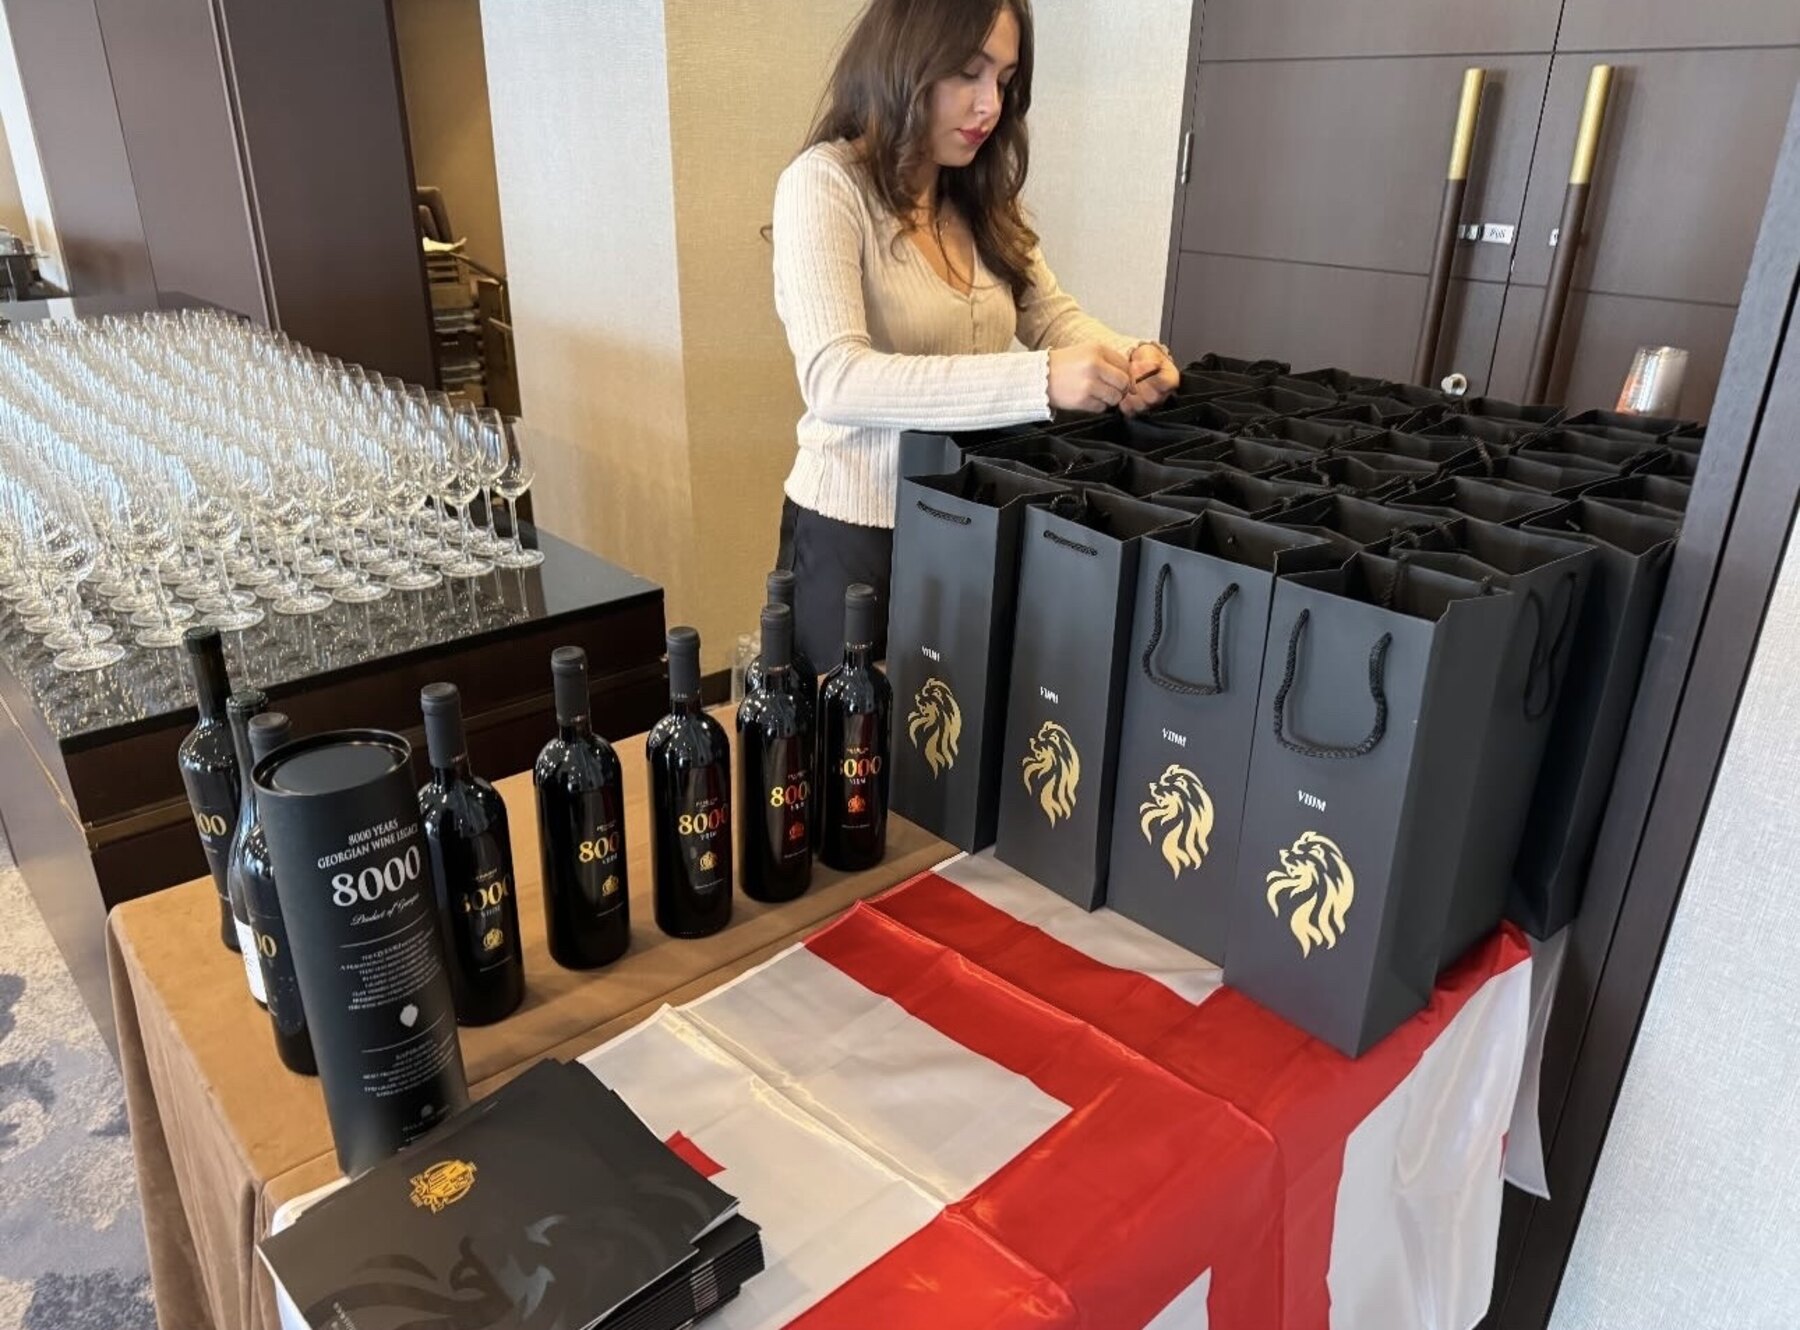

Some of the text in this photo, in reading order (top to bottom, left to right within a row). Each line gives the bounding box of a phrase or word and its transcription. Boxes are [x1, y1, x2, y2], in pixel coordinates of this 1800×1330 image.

[348, 819, 399, 846] 8000 YEARS
[317, 842, 370, 869] GEORGIAN
[370, 834, 396, 851] WINE
[331, 845, 420, 907] 8000
